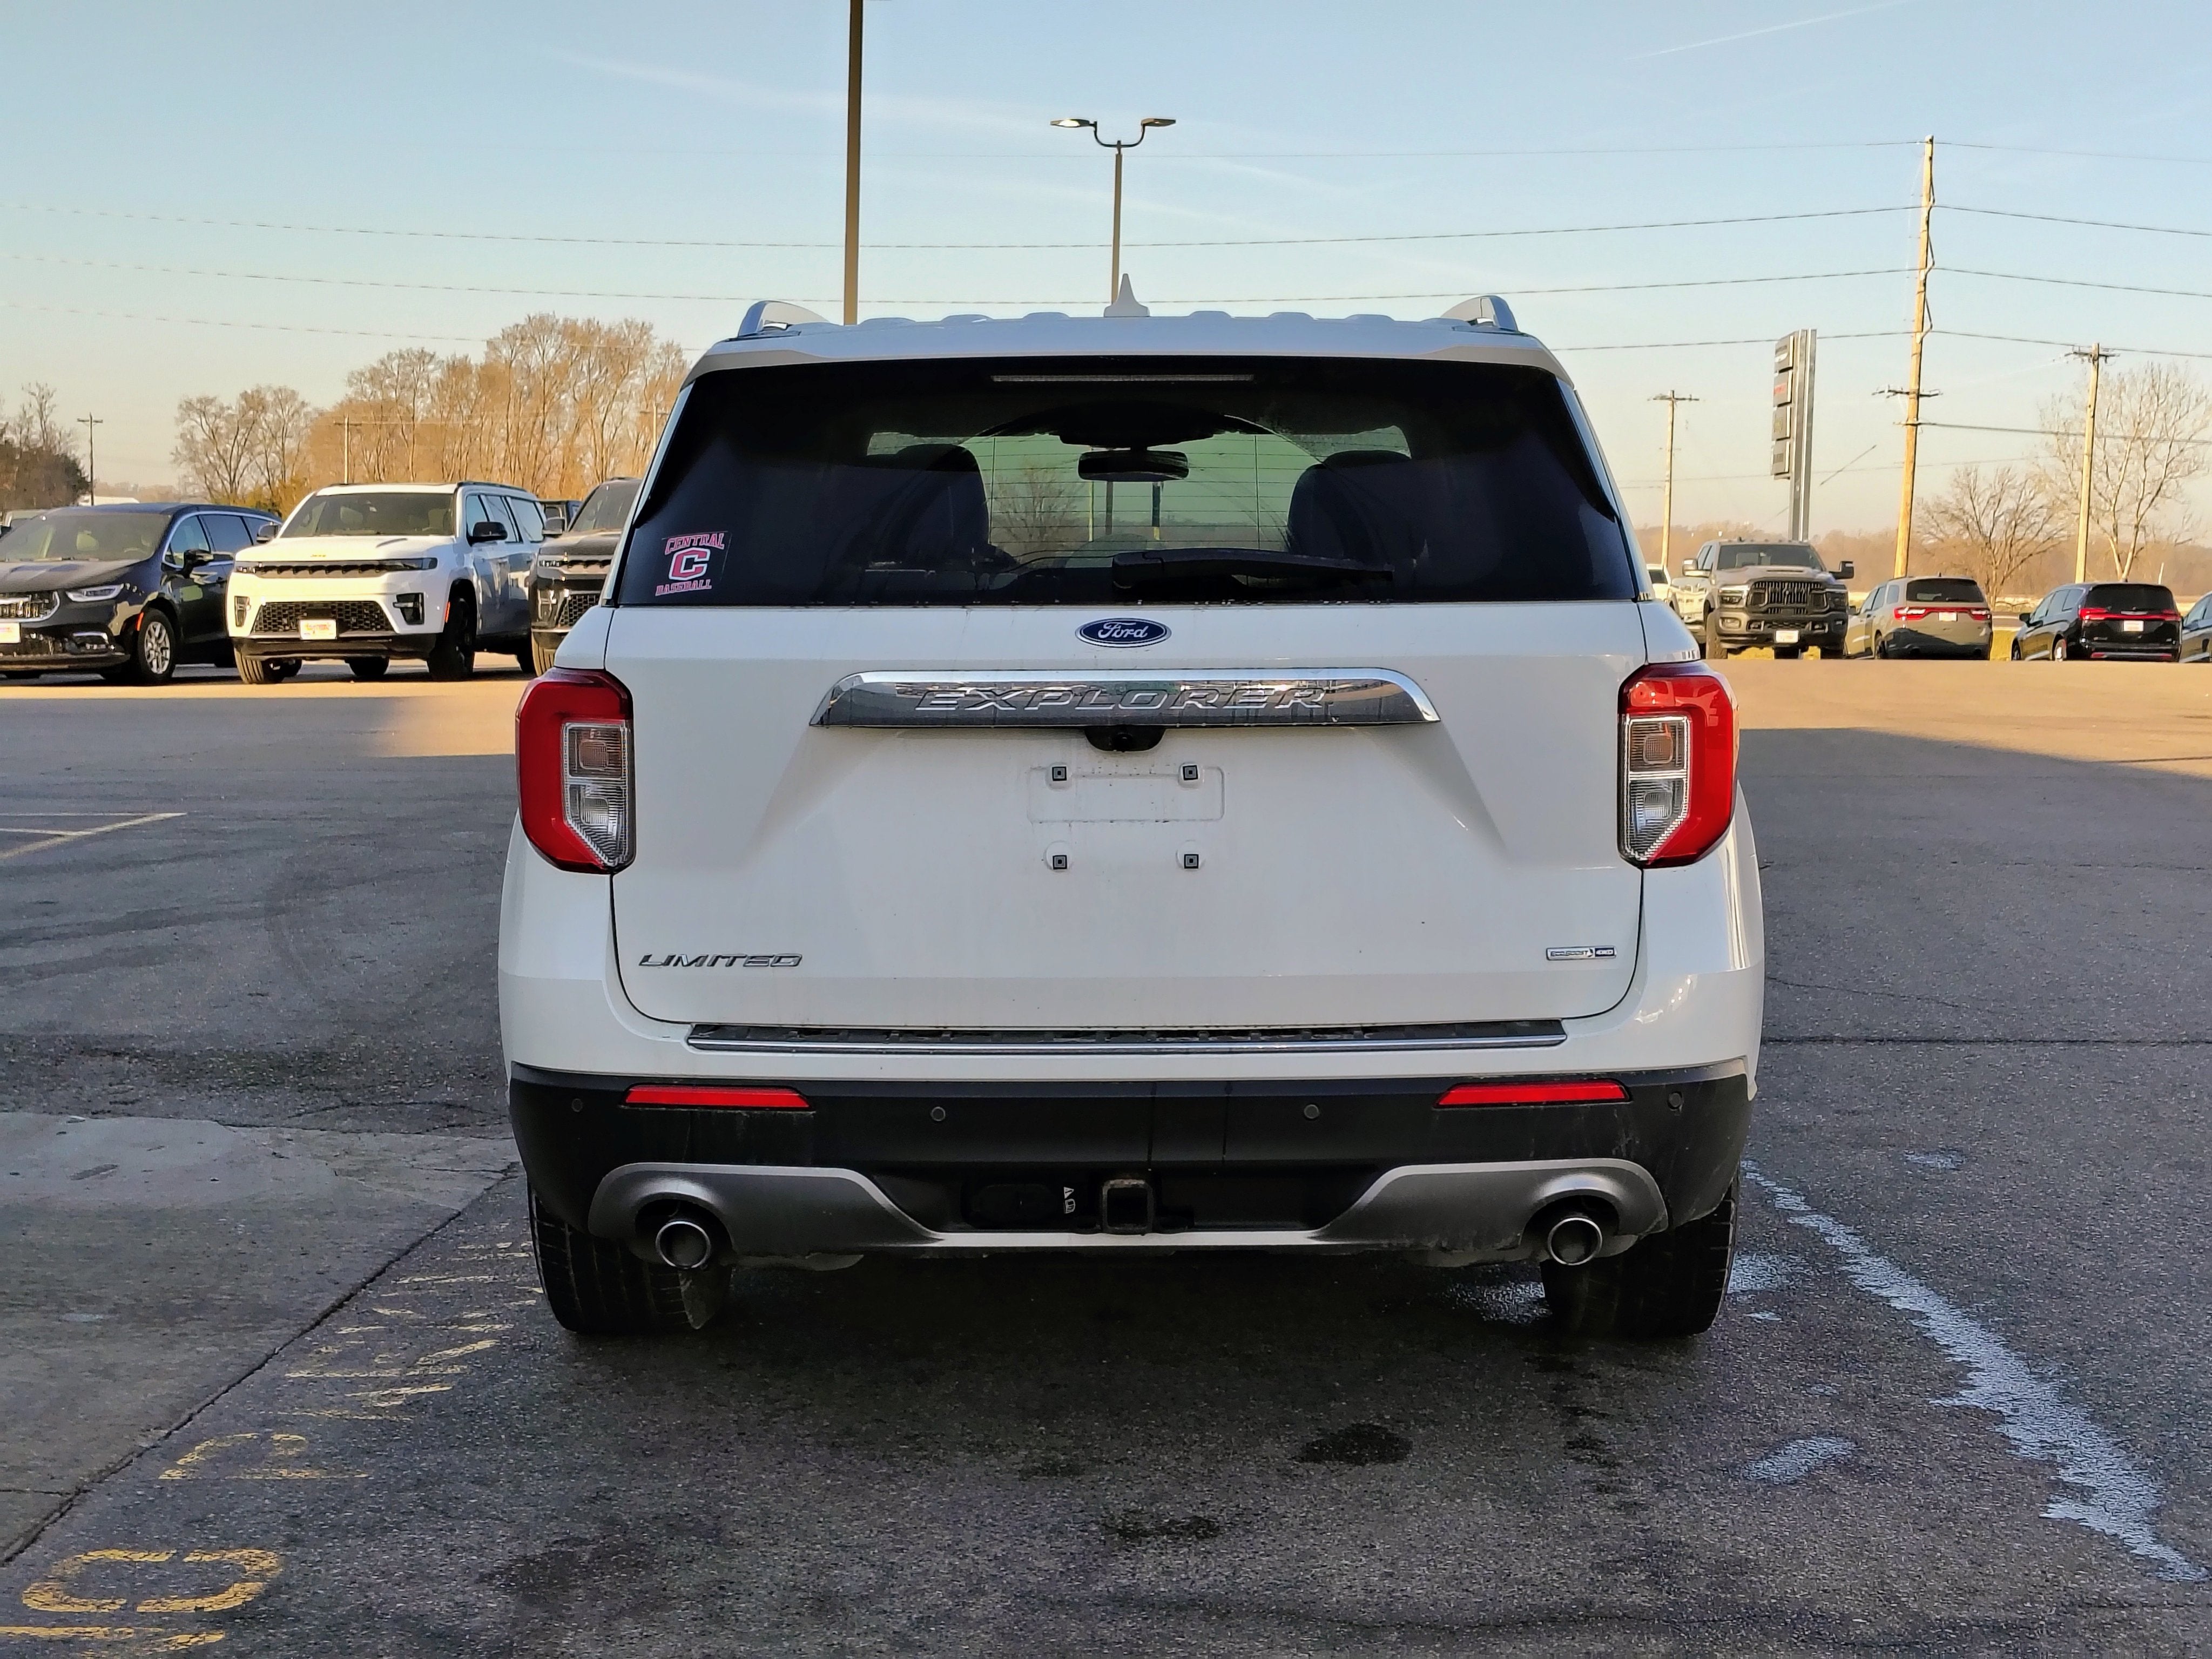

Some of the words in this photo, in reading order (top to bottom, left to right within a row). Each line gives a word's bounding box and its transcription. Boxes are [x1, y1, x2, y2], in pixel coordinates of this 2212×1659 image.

[664, 532, 725, 555] CENTRAL
[669, 547, 711, 581] C
[655, 579, 712, 596] BASEBALL
[1097, 622, 1149, 639] Ford
[914, 687, 1327, 711] EXPLORER
[638, 953, 803, 967] LIMITED
